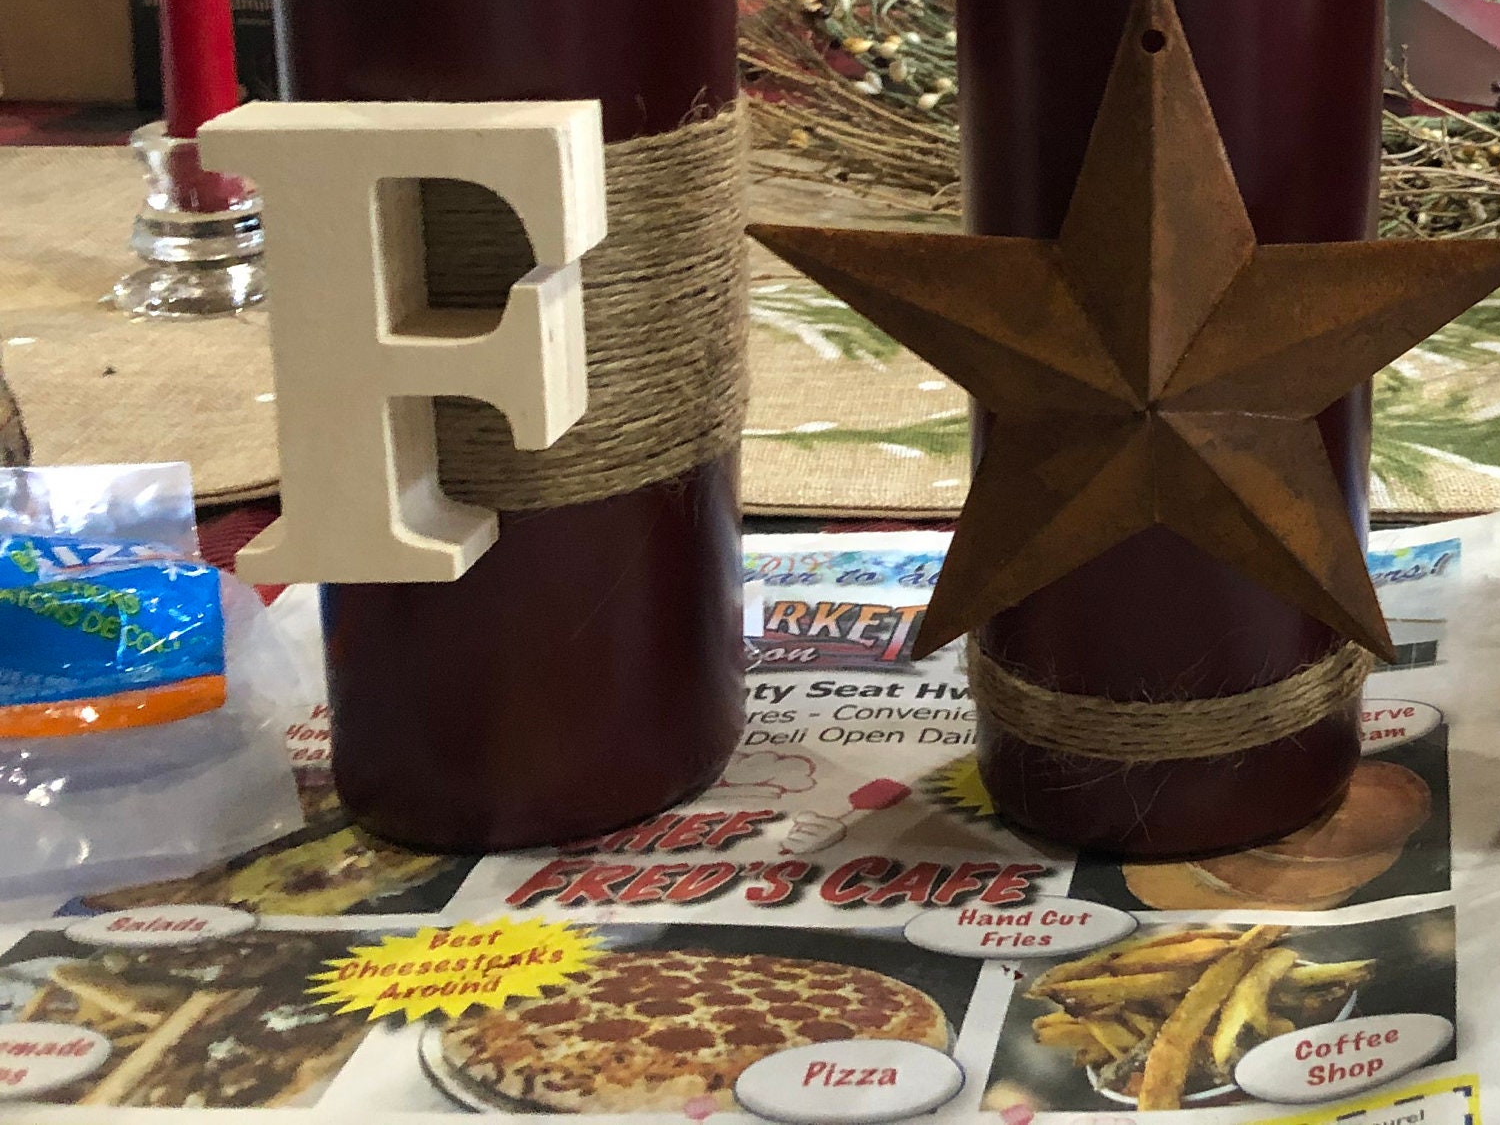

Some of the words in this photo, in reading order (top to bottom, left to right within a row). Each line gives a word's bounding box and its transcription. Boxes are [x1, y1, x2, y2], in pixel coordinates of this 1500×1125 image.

[199, 100, 607, 584] F
[766, 600, 928, 662] RKET
[805, 681, 905, 699] Seat
[832, 704, 978, 723] Convenie
[1360, 706, 1416, 723] erve
[744, 727, 809, 746] Deli
[818, 727, 910, 746] Open
[918, 727, 977, 746] Dail
[566, 810, 774, 852] HEF
[503, 857, 810, 908] FRED'S
[819, 856, 1045, 907] CAFE
[957, 907, 1033, 927] Hand
[1039, 909, 1093, 927] Cut
[428, 928, 505, 951] Best
[980, 930, 1053, 949] Fries
[376, 976, 502, 1001] Around
[1295, 1028, 1400, 1062] Coffee
[802, 1060, 898, 1088] Pizza
[1306, 1057, 1385, 1087] Shop
